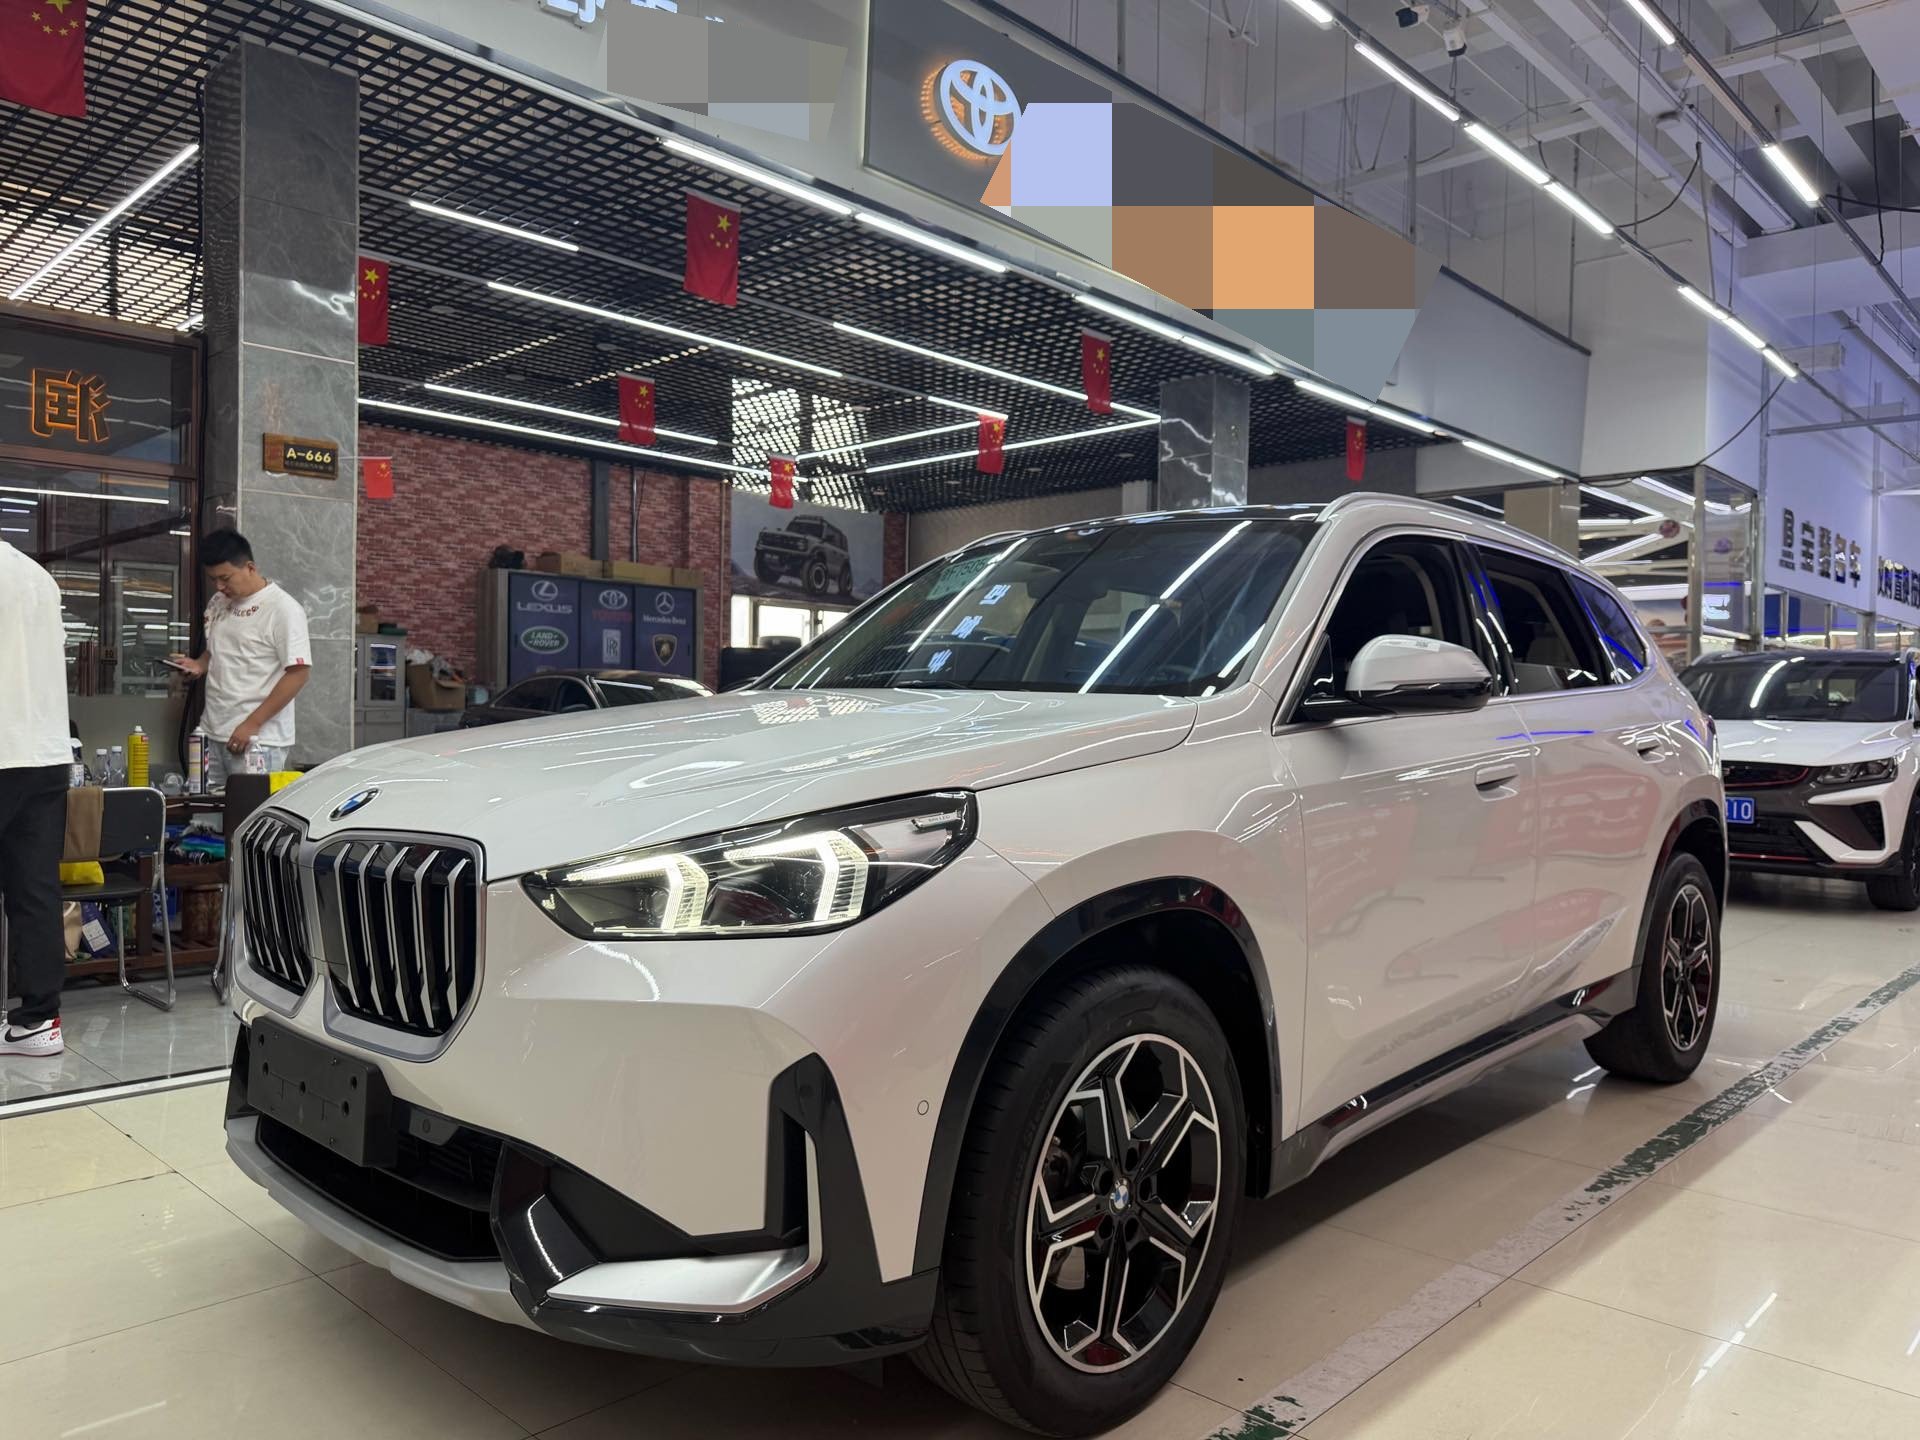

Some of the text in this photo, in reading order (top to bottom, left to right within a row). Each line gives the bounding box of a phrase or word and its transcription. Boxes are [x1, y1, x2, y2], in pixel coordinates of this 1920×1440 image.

[286, 447, 332, 464] A-666
[516, 601, 573, 614] LEXUS
[1726, 801, 1752, 820] 10
